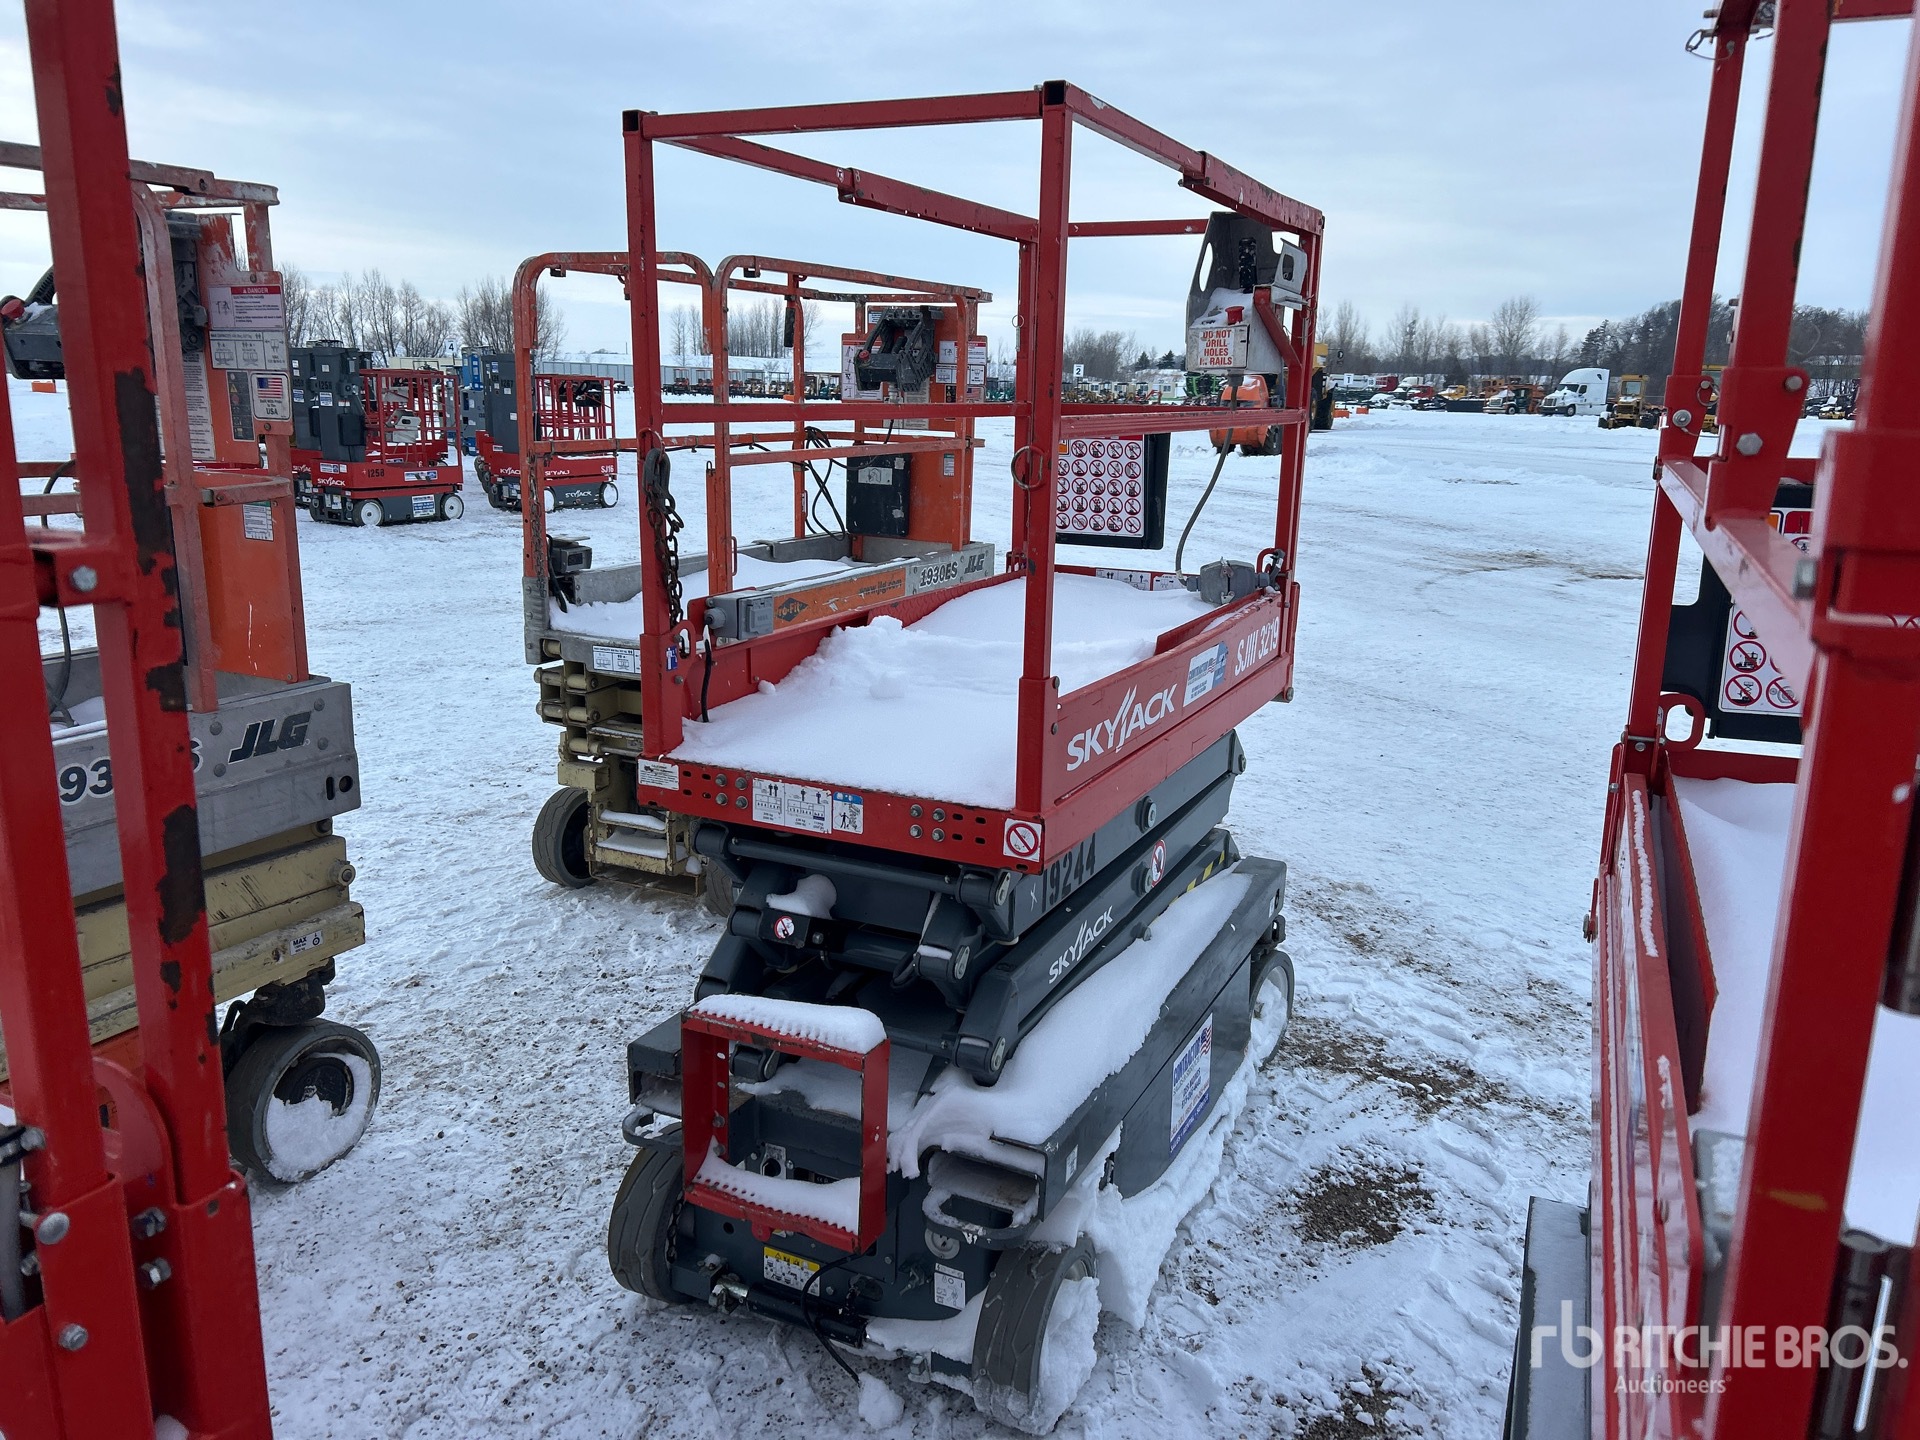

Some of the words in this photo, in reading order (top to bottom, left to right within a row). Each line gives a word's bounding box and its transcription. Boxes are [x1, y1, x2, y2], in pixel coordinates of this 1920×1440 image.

[1203, 330, 1214, 339] DO
[1215, 329, 1232, 338] NOT
[448, 343, 455, 351] 4
[1206, 339, 1228, 347] DRILL
[1204, 348, 1229, 357] HOLES
[1210, 357, 1233, 366] RAILS
[1075, 367, 1082, 376] 2
[368, 469, 385, 478] 1258
[600, 465, 614, 474] SJ16
[317, 477, 346, 487] SKYJACK
[919, 561, 959, 588] 1930ES
[964, 553, 986, 575] JLG
[776, 601, 801, 617] ro-Fit
[1258, 616, 1280, 661] 3219
[1066, 684, 1178, 772] SKYJACK
[228, 710, 313, 764] JLG
[1041, 832, 1096, 914] 19244
[293, 936, 307, 946] MAX
[1049, 905, 1114, 985] SKYJACK
